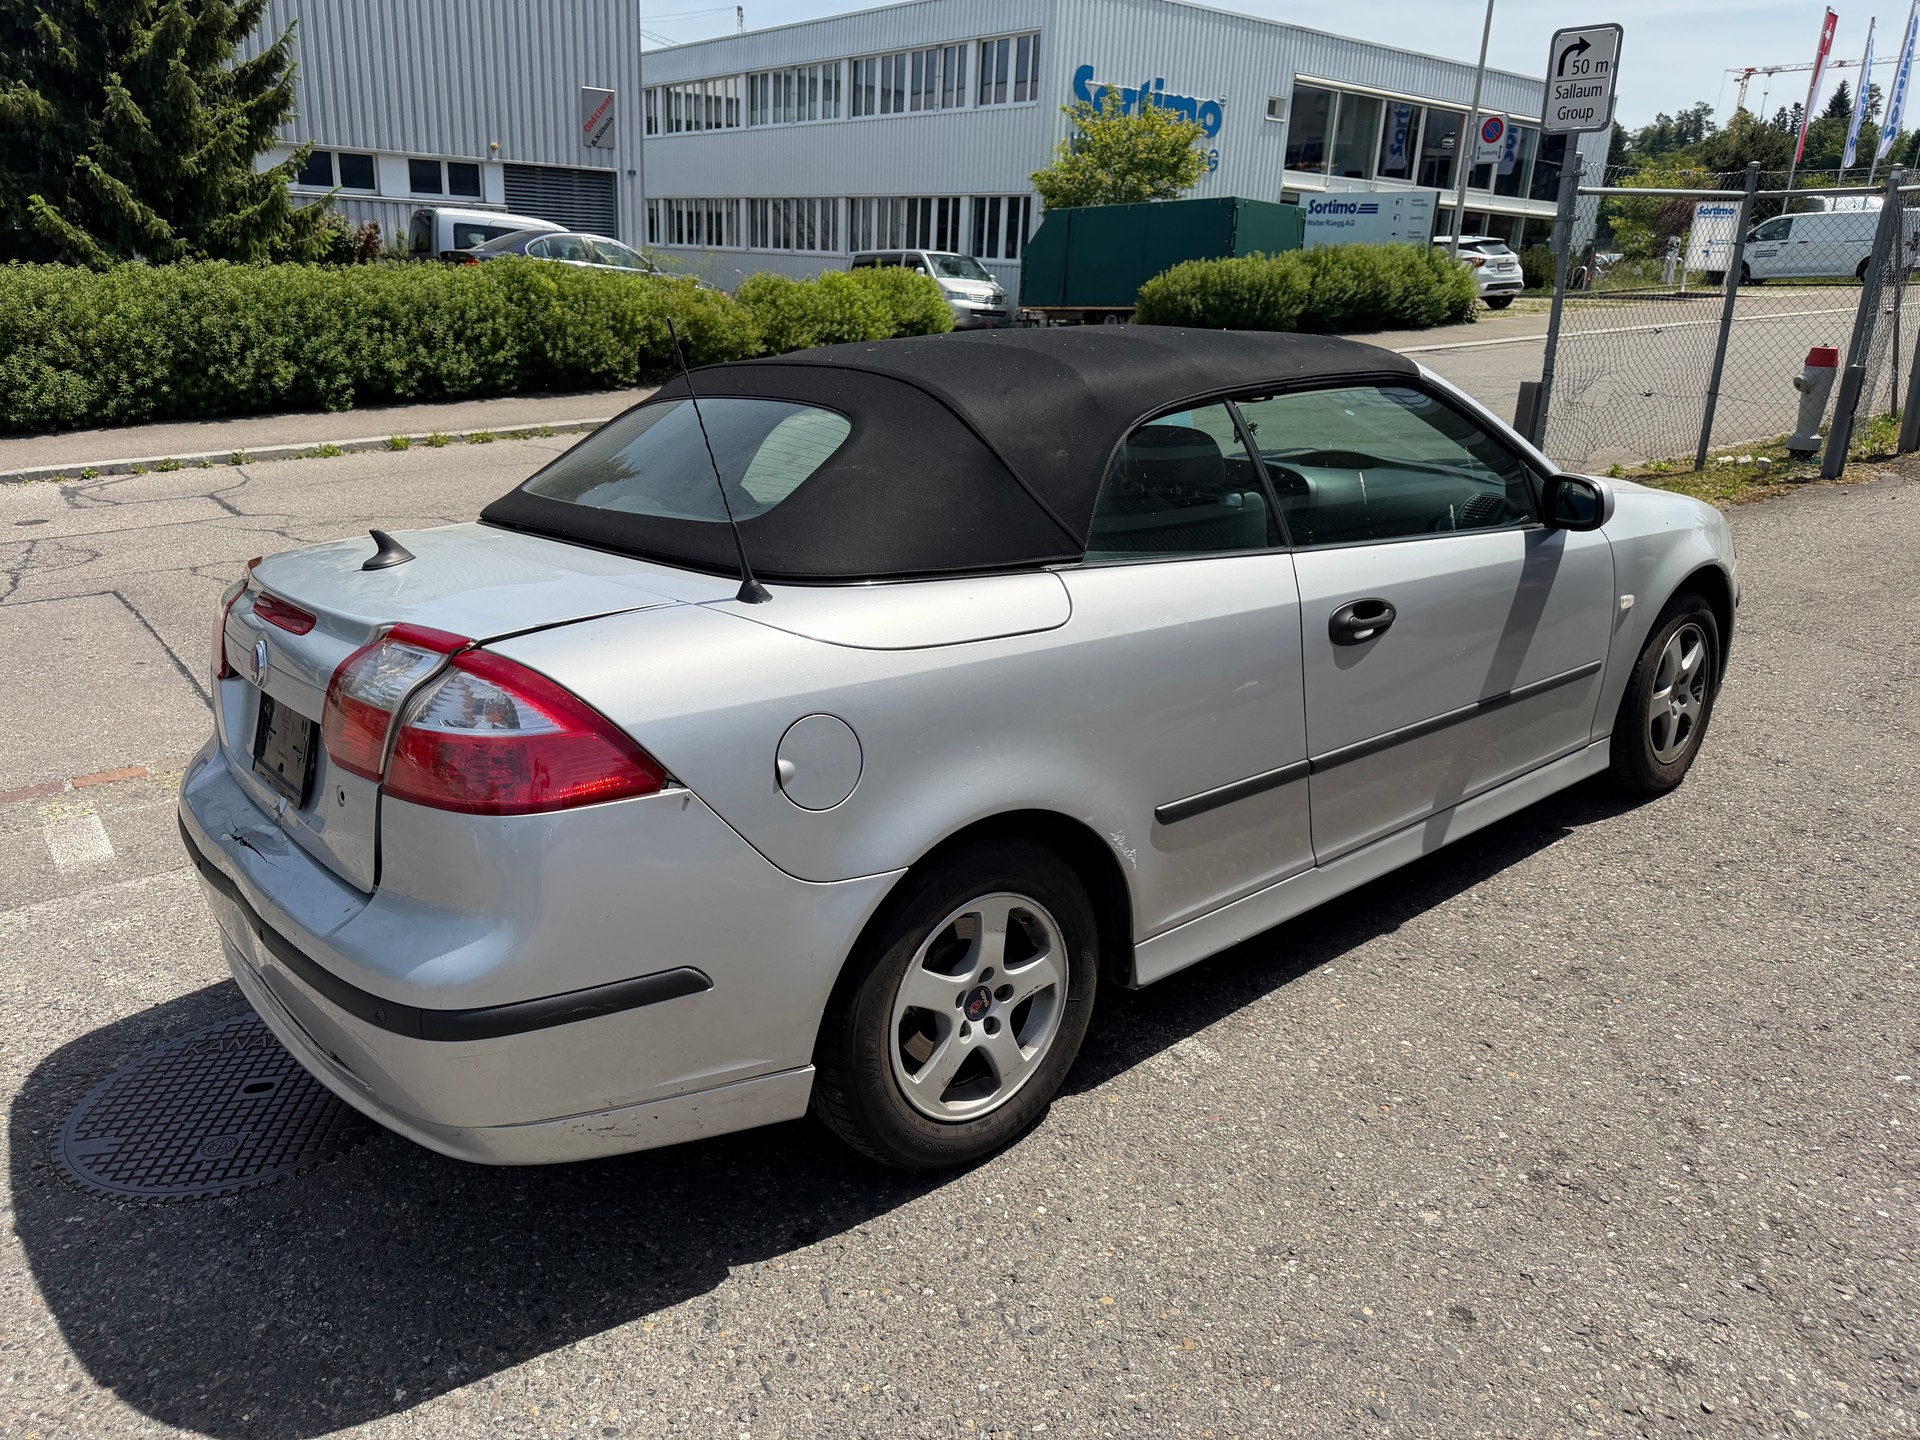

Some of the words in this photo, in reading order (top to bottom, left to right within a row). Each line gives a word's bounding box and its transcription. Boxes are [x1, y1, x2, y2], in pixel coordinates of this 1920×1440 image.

[1571, 59, 1590, 75] 50
[1595, 60, 1609, 73] m
[1554, 83, 1603, 100] Sallaum
[584, 94, 613, 132] Oldtimer
[1557, 106, 1594, 122] Group
[1308, 199, 1357, 214] Sortimo
[1697, 205, 1735, 215] Sortimo
[1345, 219, 1355, 227] AG
